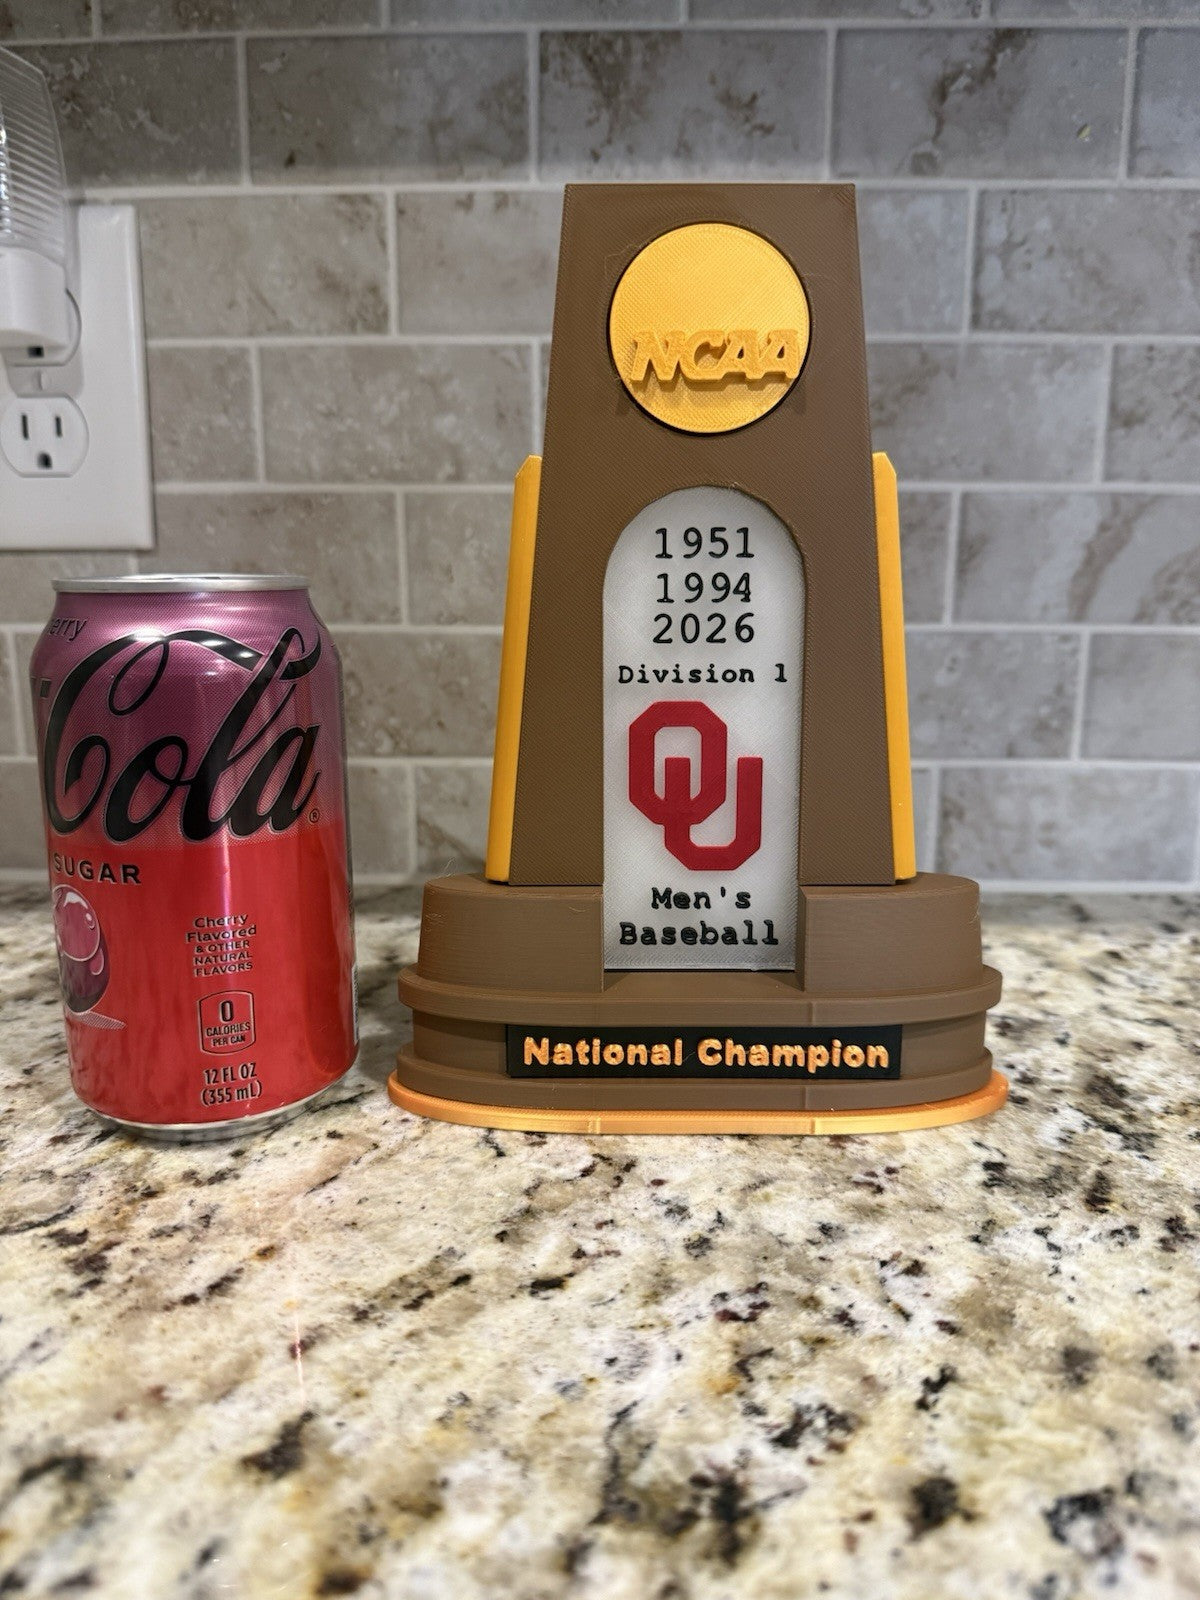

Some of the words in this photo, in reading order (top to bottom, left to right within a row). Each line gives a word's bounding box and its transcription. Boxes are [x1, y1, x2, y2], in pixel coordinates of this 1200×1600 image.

[631, 330, 800, 381] NCAA
[655, 527, 755, 558] 1951
[656, 572, 752, 603] 1994
[652, 612, 755, 644] 2026
[618, 664, 755, 684] Division
[628, 701, 763, 871] OU
[53, 852, 141, 885] SUGAR
[651, 887, 751, 909] Men's
[194, 914, 249, 928] Cherry
[619, 919, 779, 945] Baseball
[185, 924, 257, 943] Flavored
[207, 940, 250, 952] OTHER
[194, 951, 253, 966] NATURAL
[194, 961, 253, 977] FLAVORS
[220, 1000, 234, 1023] 0
[206, 1021, 251, 1037] CALORIES
[212, 1036, 228, 1047] PER
[230, 1034, 246, 1044] CAN
[523, 1036, 682, 1066] National
[697, 1037, 890, 1073] Champion
[205, 1068, 220, 1085] 12
[222, 1066, 236, 1083] FL
[239, 1062, 257, 1080] OZ
[202, 1087, 232, 1107] (355
[235, 1079, 262, 1101] mL)
